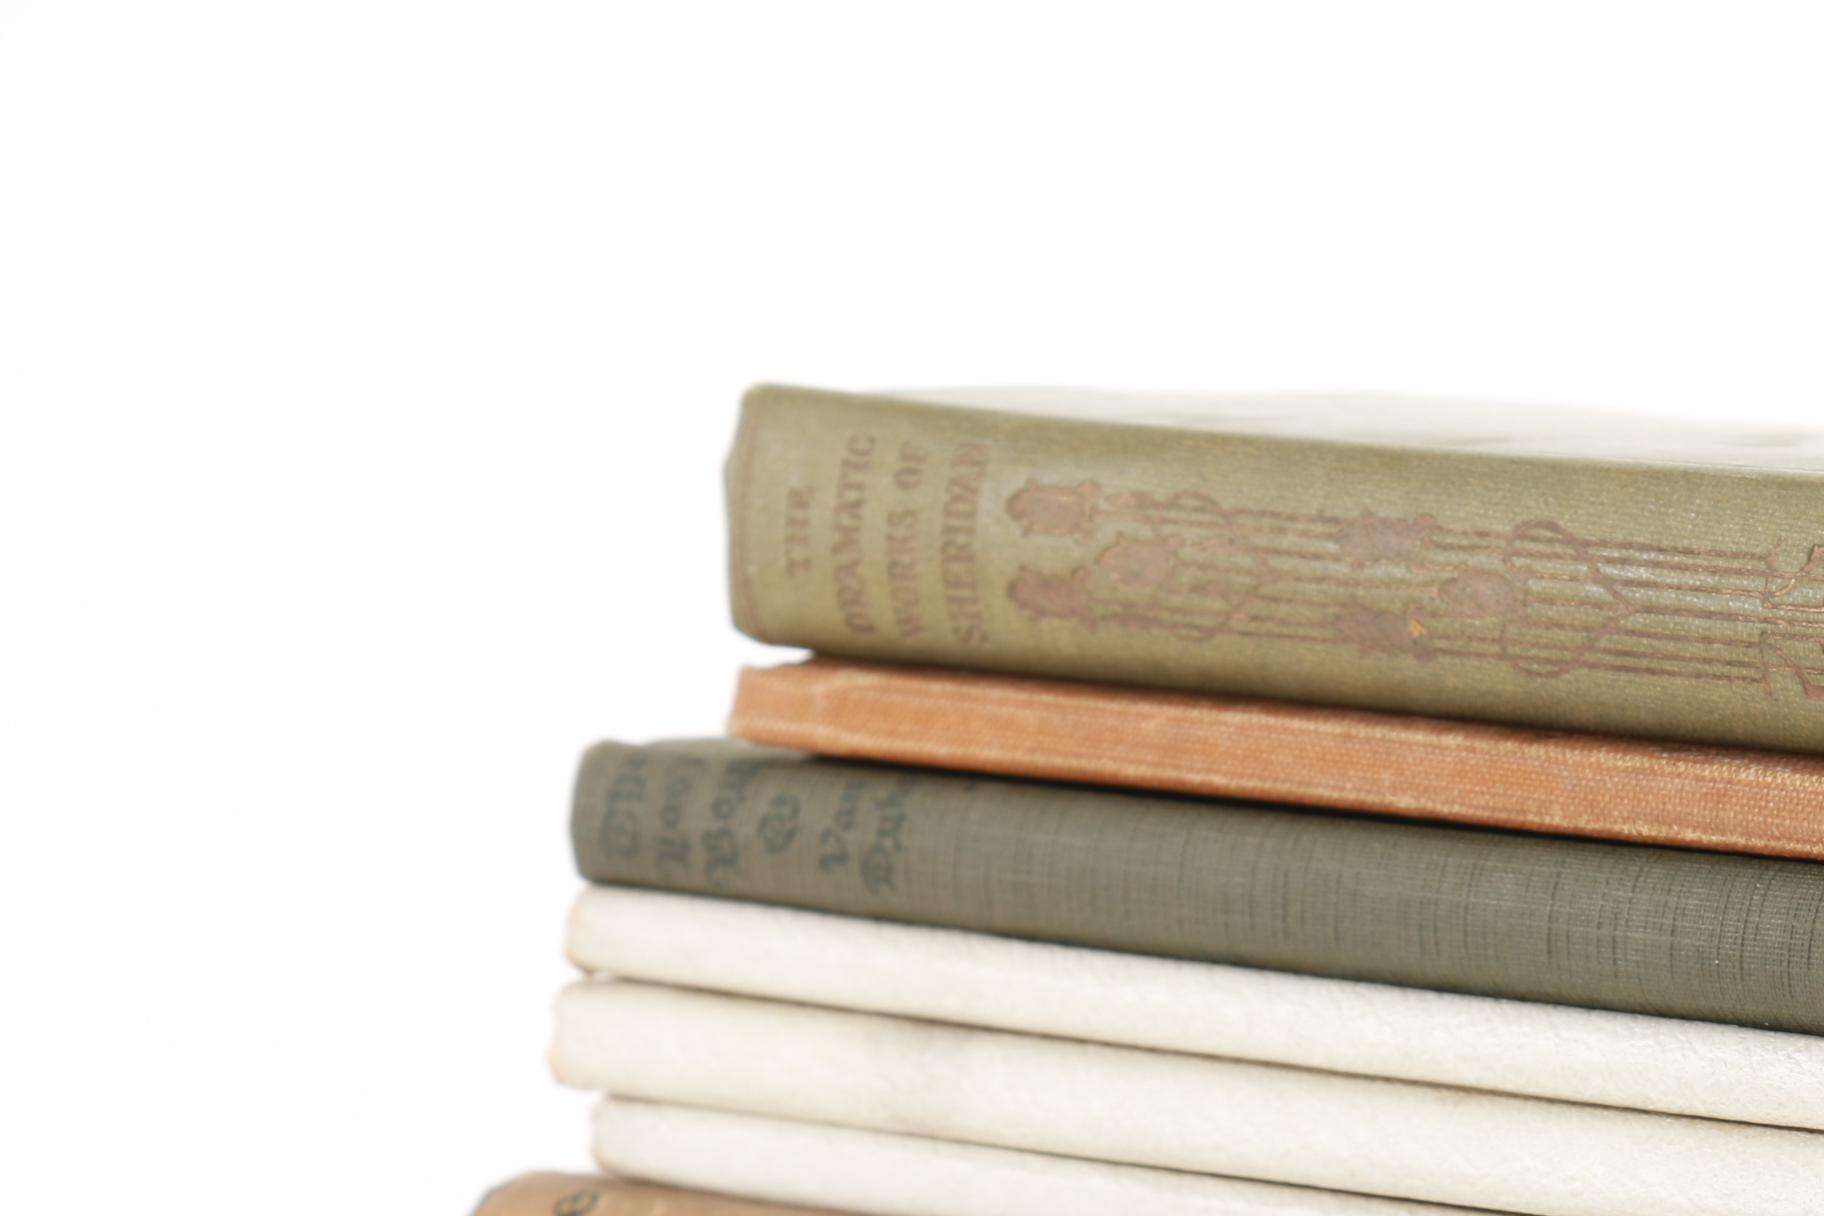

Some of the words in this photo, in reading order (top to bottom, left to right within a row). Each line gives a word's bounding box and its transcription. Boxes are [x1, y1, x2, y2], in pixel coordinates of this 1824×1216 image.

[896, 442, 928, 489] OF
[783, 484, 814, 578] THE
[831, 434, 876, 634] DRAMATIC
[885, 509, 922, 639] WORKS
[939, 443, 991, 644] SHERIDAN
